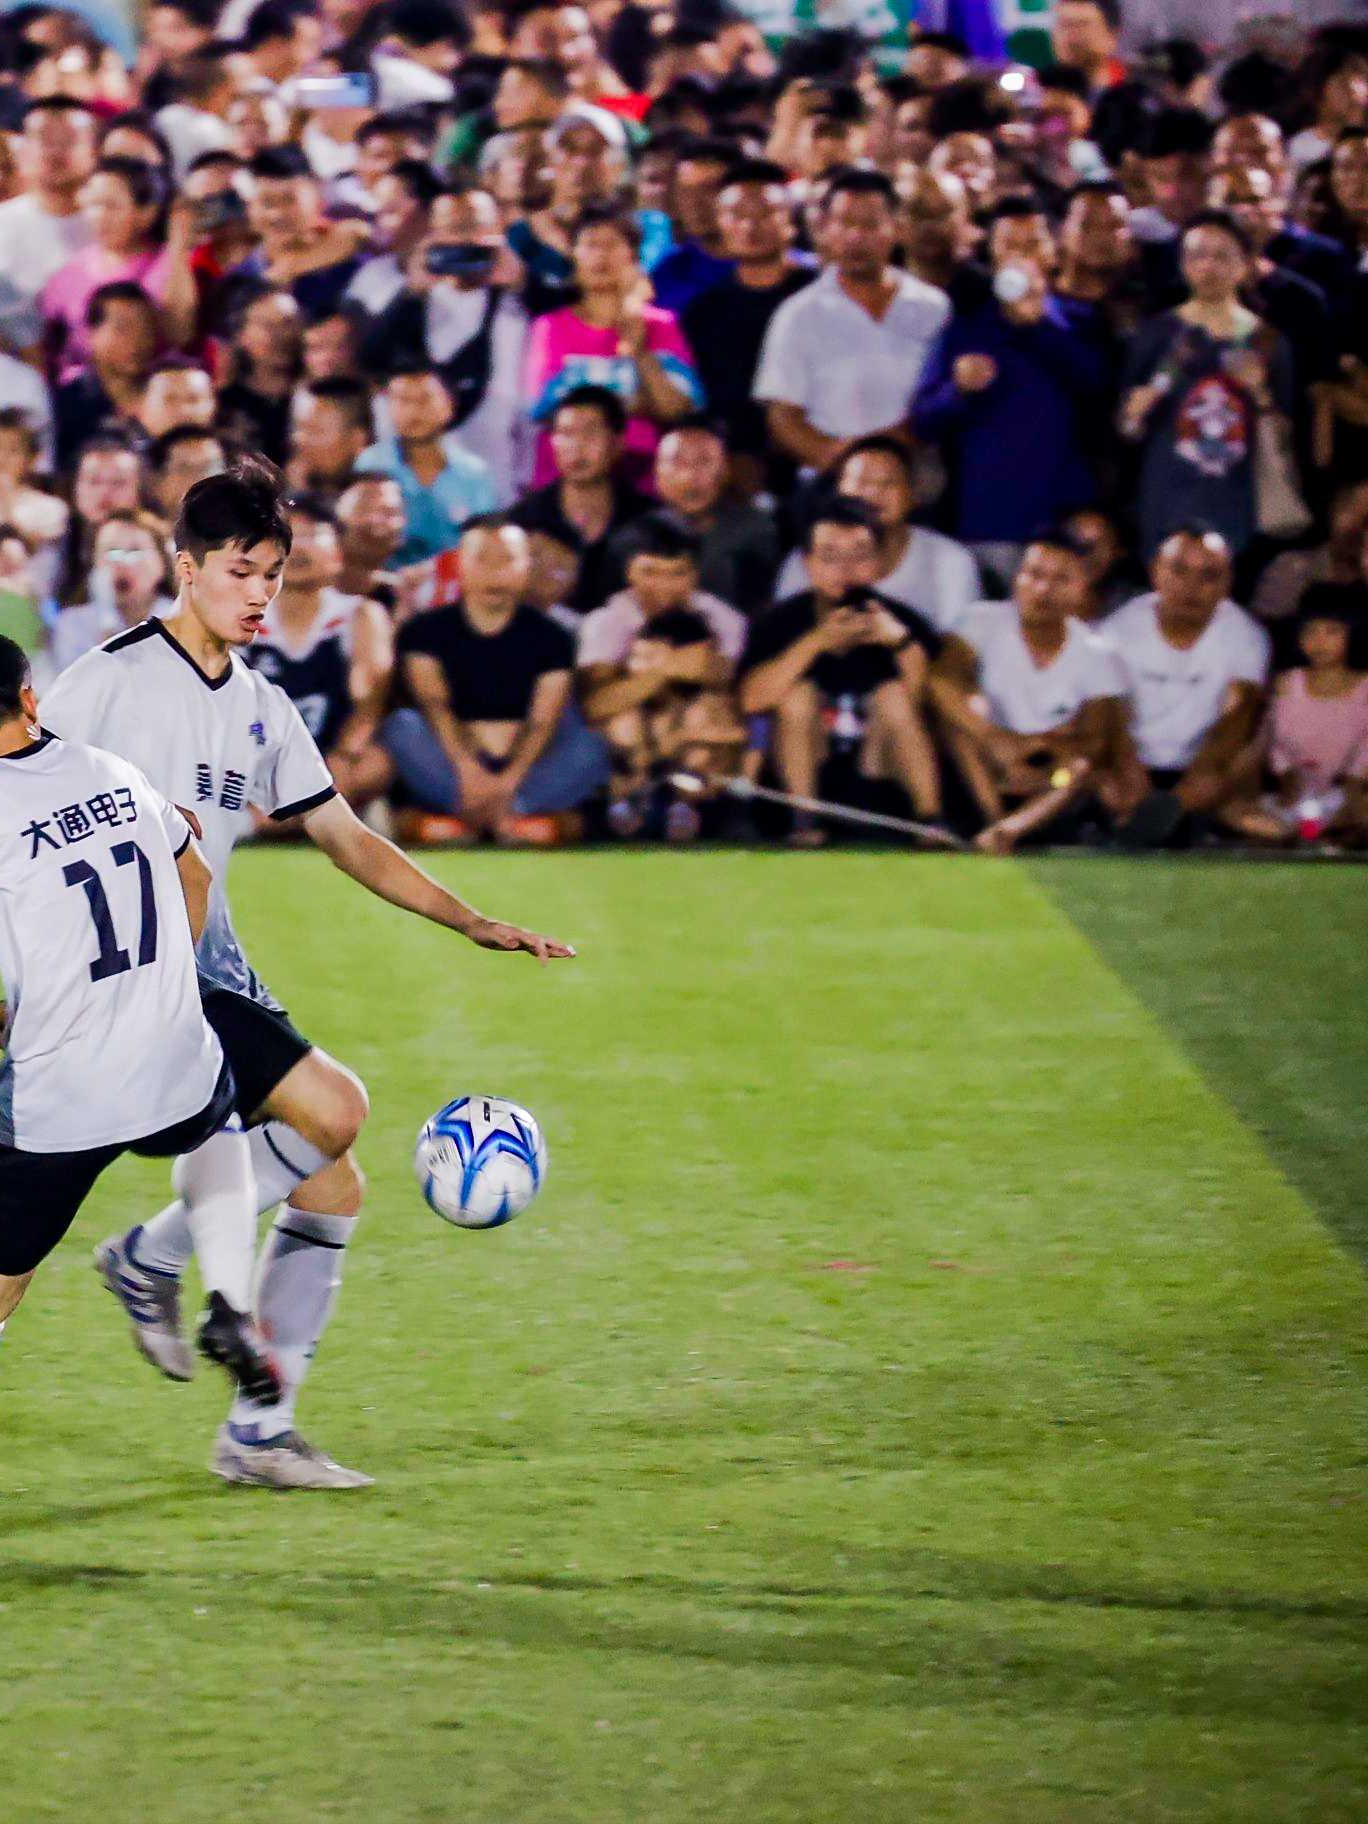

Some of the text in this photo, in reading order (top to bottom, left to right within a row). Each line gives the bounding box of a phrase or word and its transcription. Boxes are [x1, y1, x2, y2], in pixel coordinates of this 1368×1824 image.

[20, 787, 138, 860] 大通电子
[62, 840, 158, 983] 17
